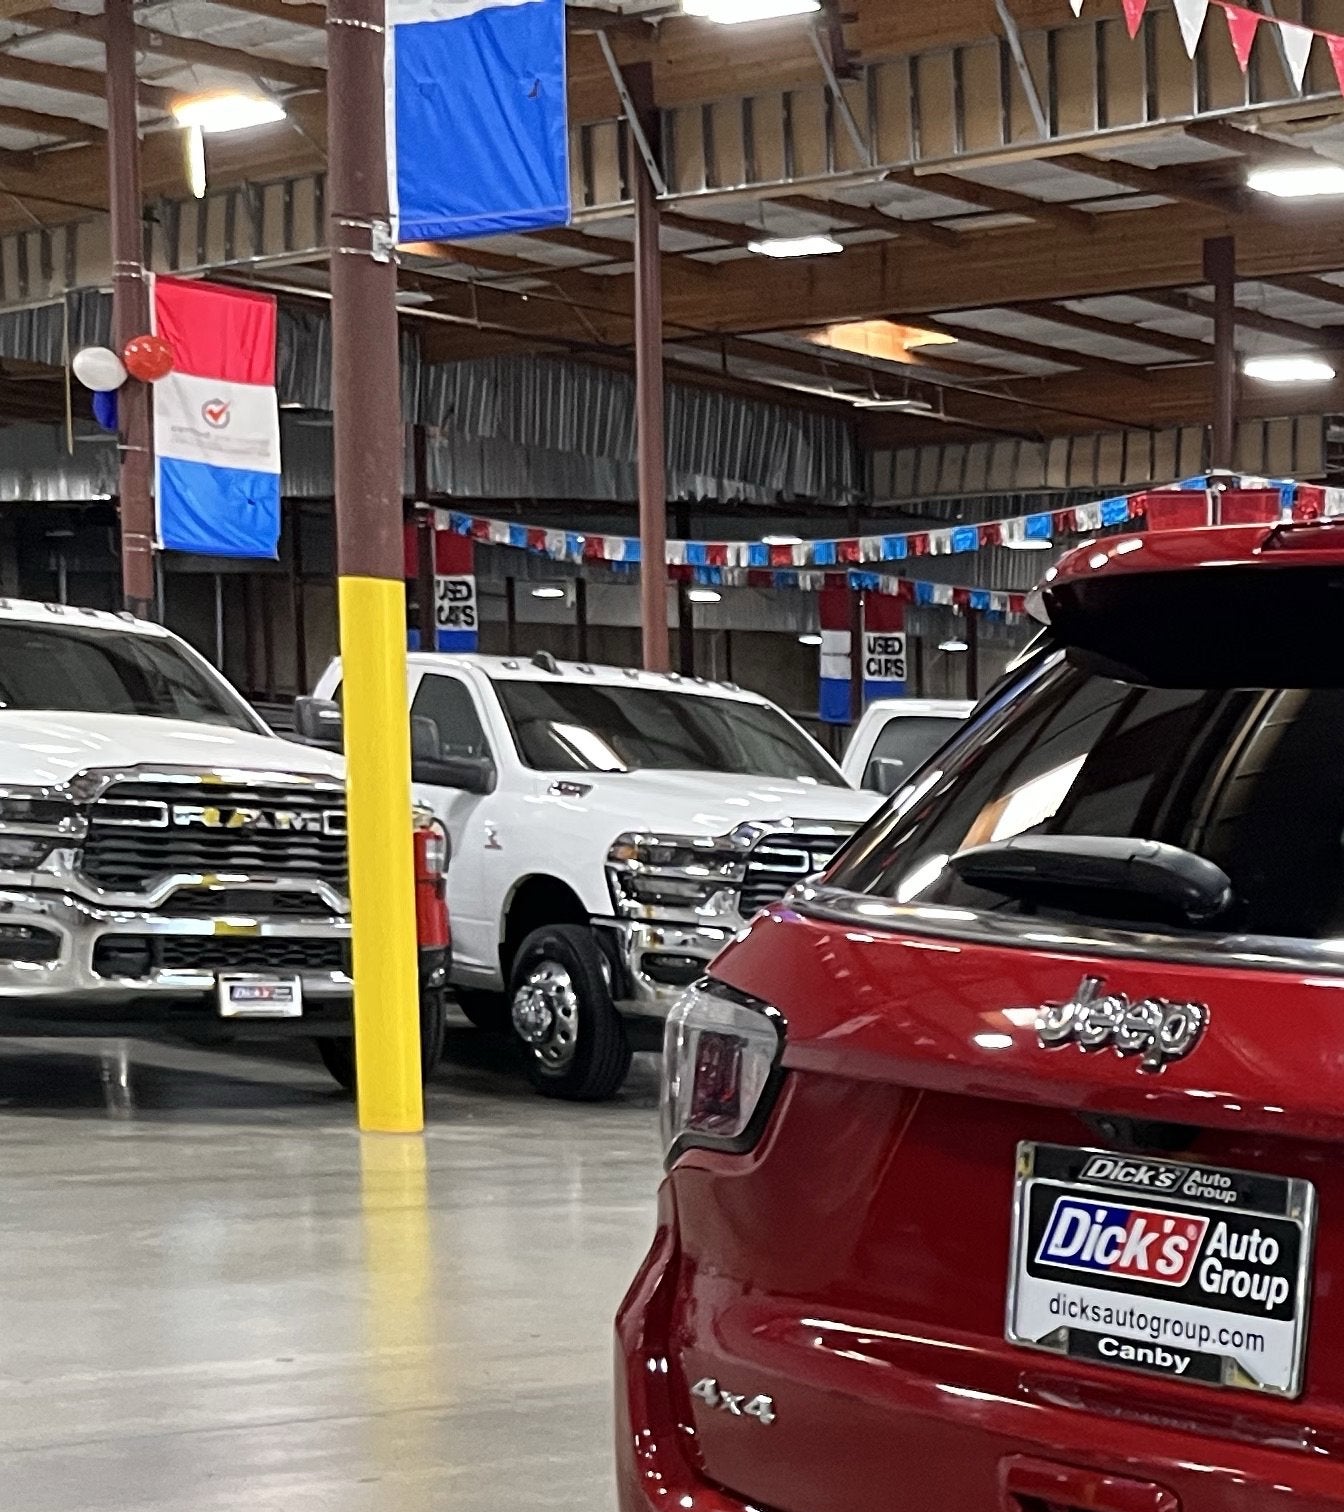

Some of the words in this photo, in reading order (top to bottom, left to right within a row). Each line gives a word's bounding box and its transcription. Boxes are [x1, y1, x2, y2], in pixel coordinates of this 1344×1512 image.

[867, 636, 903, 655] USED
[1035, 973, 1210, 1075] Jeep
[1086, 1159, 1177, 1187] Dick's
[1183, 1182, 1238, 1203] Group
[1187, 1170, 1232, 1188] Auto
[1047, 1207, 1191, 1276] Dick's
[1205, 1221, 1279, 1266] Auto
[1199, 1257, 1290, 1310] Group
[1048, 1293, 1266, 1353] dicksautogroup.com
[1097, 1337, 1191, 1374] Canby
